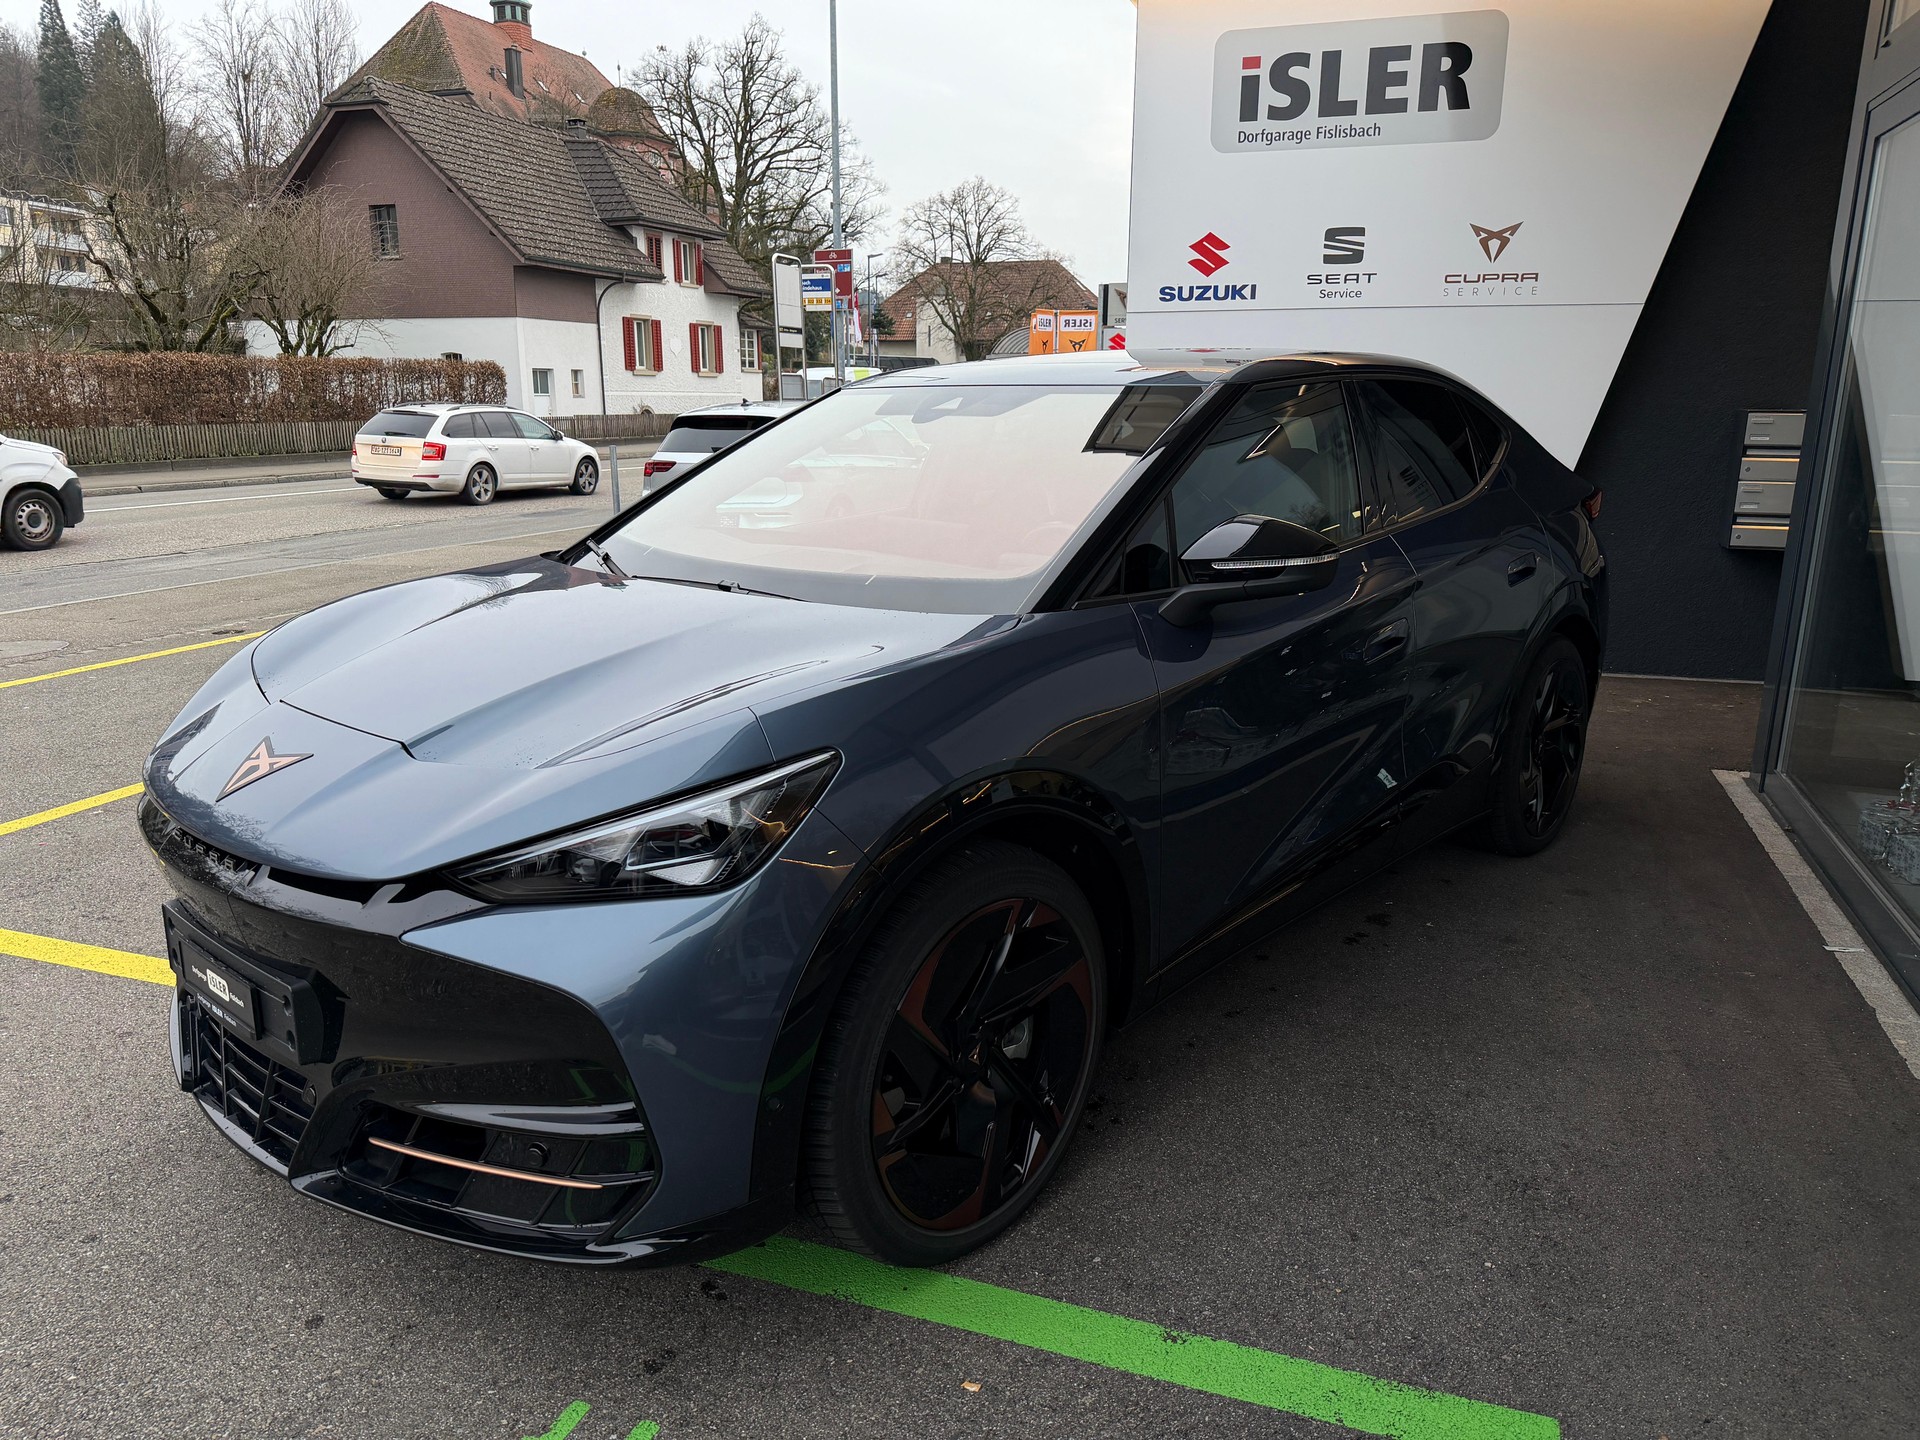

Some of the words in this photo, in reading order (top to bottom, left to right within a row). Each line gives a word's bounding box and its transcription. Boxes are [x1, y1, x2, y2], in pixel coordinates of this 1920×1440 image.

[1238, 41, 1473, 123] iSLER
[1237, 128, 1312, 146] Dorfgarage
[1316, 123, 1381, 141] Fislisbach
[1306, 272, 1377, 285] SEAT
[1443, 272, 1539, 284] CUPRA
[1158, 283, 1257, 303] SUZUKI
[1318, 287, 1363, 299] Service
[1442, 285, 1538, 298] SERVICE
